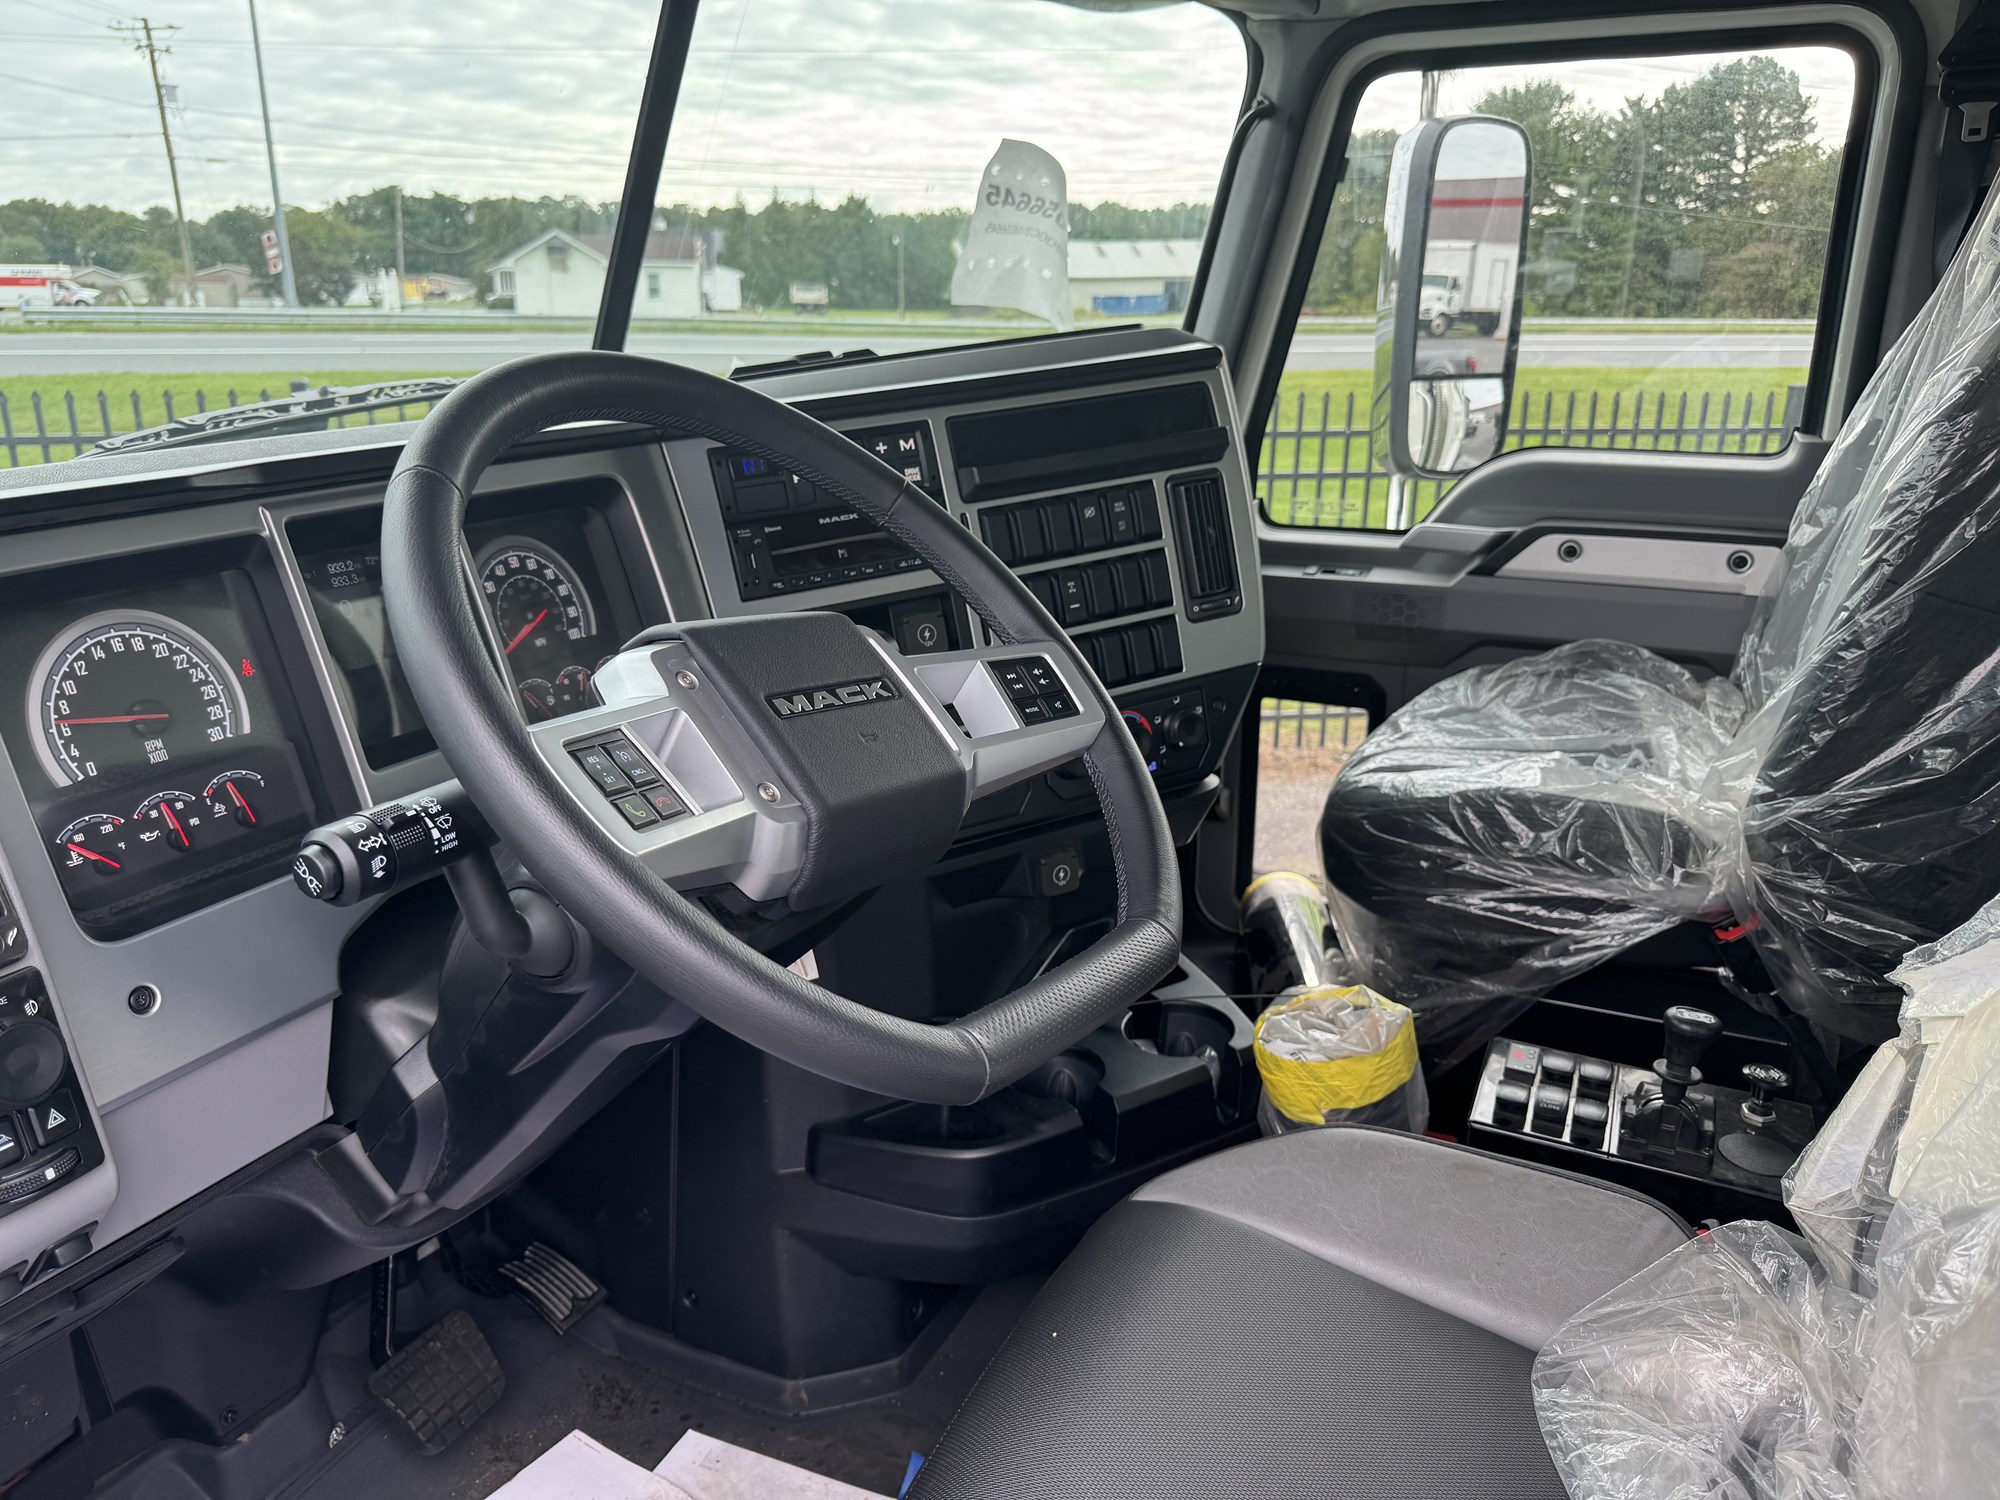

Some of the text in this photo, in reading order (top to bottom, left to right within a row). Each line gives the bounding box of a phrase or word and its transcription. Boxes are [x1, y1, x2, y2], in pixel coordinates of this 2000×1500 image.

[899, 437, 916, 451] M
[818, 512, 859, 525] MACK
[327, 560, 355, 575] 933.2
[508, 556, 520, 568] 50
[526, 558, 538, 571] 60
[495, 564, 506, 577] 40
[544, 568, 555, 580] 70
[331, 574, 359, 588] 933.3
[484, 581, 496, 594] 30
[558, 584, 569, 597] 80
[567, 605, 578, 618] 90
[568, 627, 581, 641] 100
[110, 637, 125, 653] 16
[131, 636, 145, 651] 18
[152, 642, 169, 659] 20
[92, 645, 106, 661] 14
[73, 661, 88, 676] 12
[172, 654, 190, 670] 22
[189, 668, 206, 683] 24
[62, 681, 77, 696] 10
[201, 684, 217, 700] 26
[771, 682, 892, 716] MACK
[58, 700, 70, 714] 8
[207, 704, 224, 720] 28
[61, 722, 72, 737] 6
[207, 726, 224, 742] 30
[70, 744, 80, 758] 4
[144, 738, 164, 753] RPM
[147, 748, 169, 764] X100
[586, 755, 599, 764] RES
[86, 762, 98, 777] 0
[604, 775, 616, 784] SET
[428, 804, 442, 815] OFF
[100, 823, 114, 835] 220
[189, 817, 201, 827] PSI
[441, 831, 456, 844] LOW
[441, 839, 458, 852] HIGH
